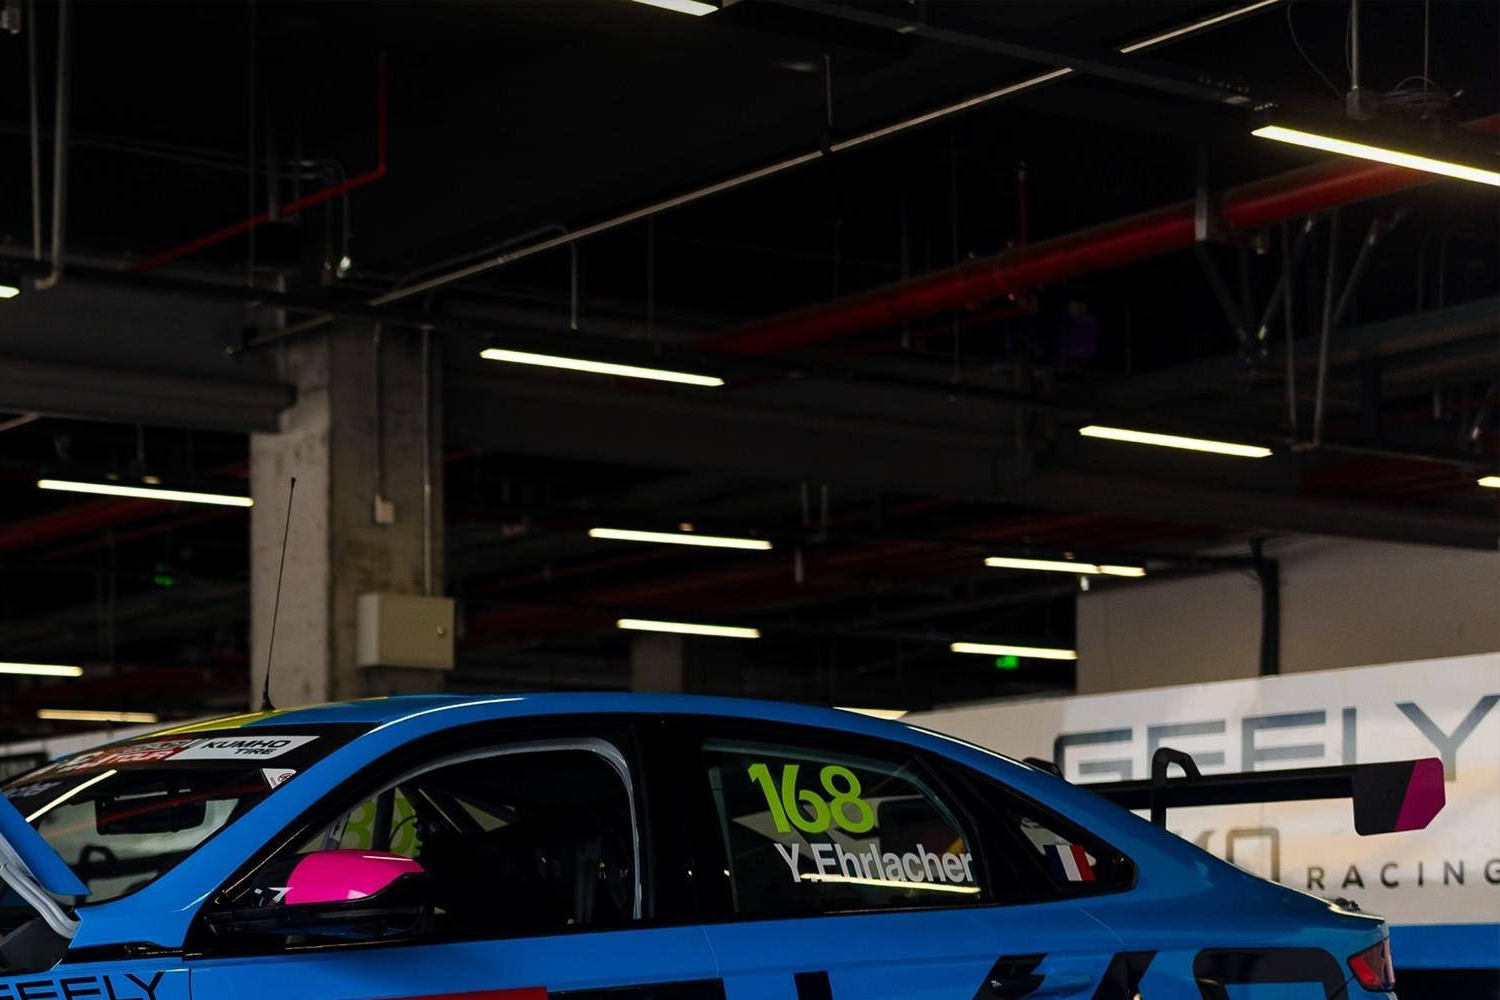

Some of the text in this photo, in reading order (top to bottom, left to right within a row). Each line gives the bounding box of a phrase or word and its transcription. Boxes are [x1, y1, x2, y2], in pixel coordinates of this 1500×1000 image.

[201, 740, 291, 749] KUMHO
[748, 763, 875, 834] 168
[1306, 857, 1500, 890] RACING
